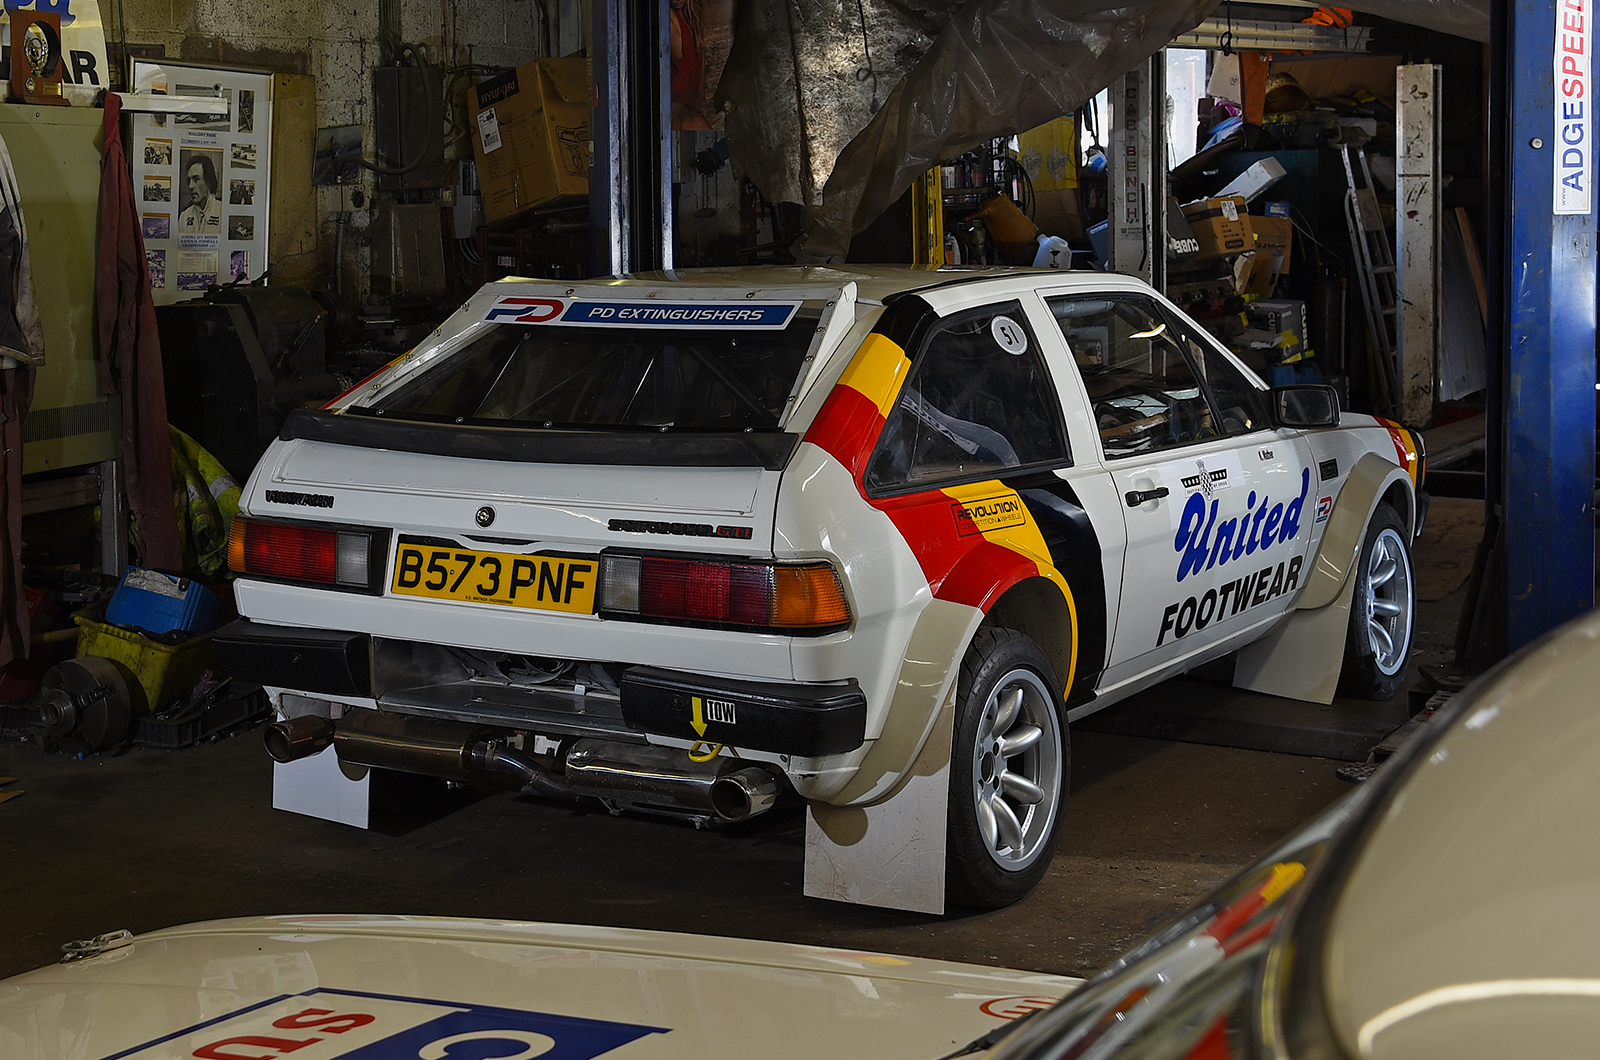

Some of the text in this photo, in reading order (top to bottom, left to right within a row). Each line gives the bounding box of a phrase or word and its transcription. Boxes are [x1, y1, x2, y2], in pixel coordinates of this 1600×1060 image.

[587, 307, 765, 322] PD EXTINGUISHERS
[999, 325, 1020, 346] 51
[956, 500, 1019, 521] REVOLUTION
[1174, 467, 1310, 582] United
[398, 548, 592, 605] B573 PNF
[1156, 555, 1303, 647] FOOTWEAR
[707, 700, 734, 723] TOW
